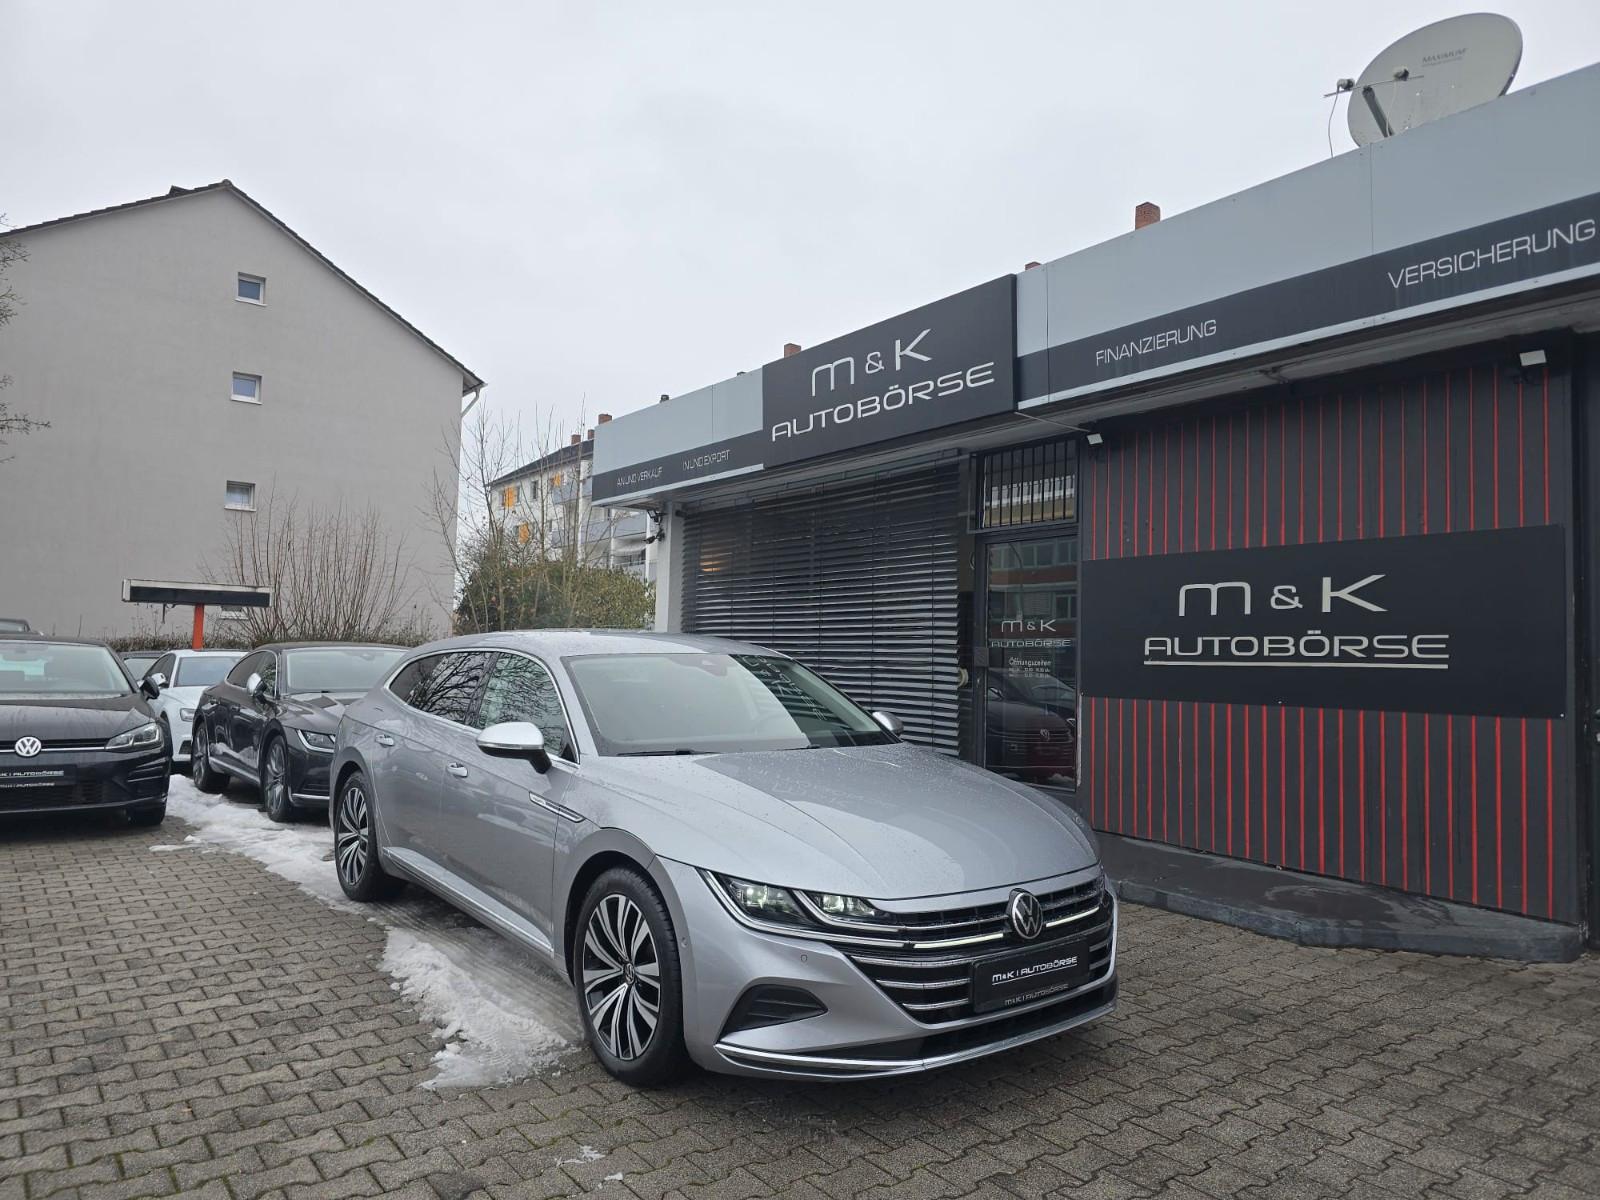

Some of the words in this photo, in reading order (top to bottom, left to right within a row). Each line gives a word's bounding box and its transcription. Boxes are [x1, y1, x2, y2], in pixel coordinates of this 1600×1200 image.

[1387, 218, 1597, 289] VERSICHERUNG
[1095, 319, 1217, 367] FINANZIERUNG
[811, 356, 855, 397] M
[864, 351, 885, 374] &
[895, 328, 933, 371] K
[771, 361, 995, 442] AUTOBÖRSE
[703, 449, 731, 466] EXPORT
[637, 466, 663, 482] VERKAUF
[1178, 581, 1251, 617] M
[1270, 585, 1303, 610] &
[1321, 574, 1388, 613] K
[1001, 620, 1023, 633] M
[1026, 621, 1037, 631] &
[1040, 619, 1057, 632] K
[991, 638, 1072, 648] AUTOBÖRSE
[1144, 629, 1449, 658] AUTOBÖRSE
[1020, 956, 1078, 976] AUTOBÖRSE
